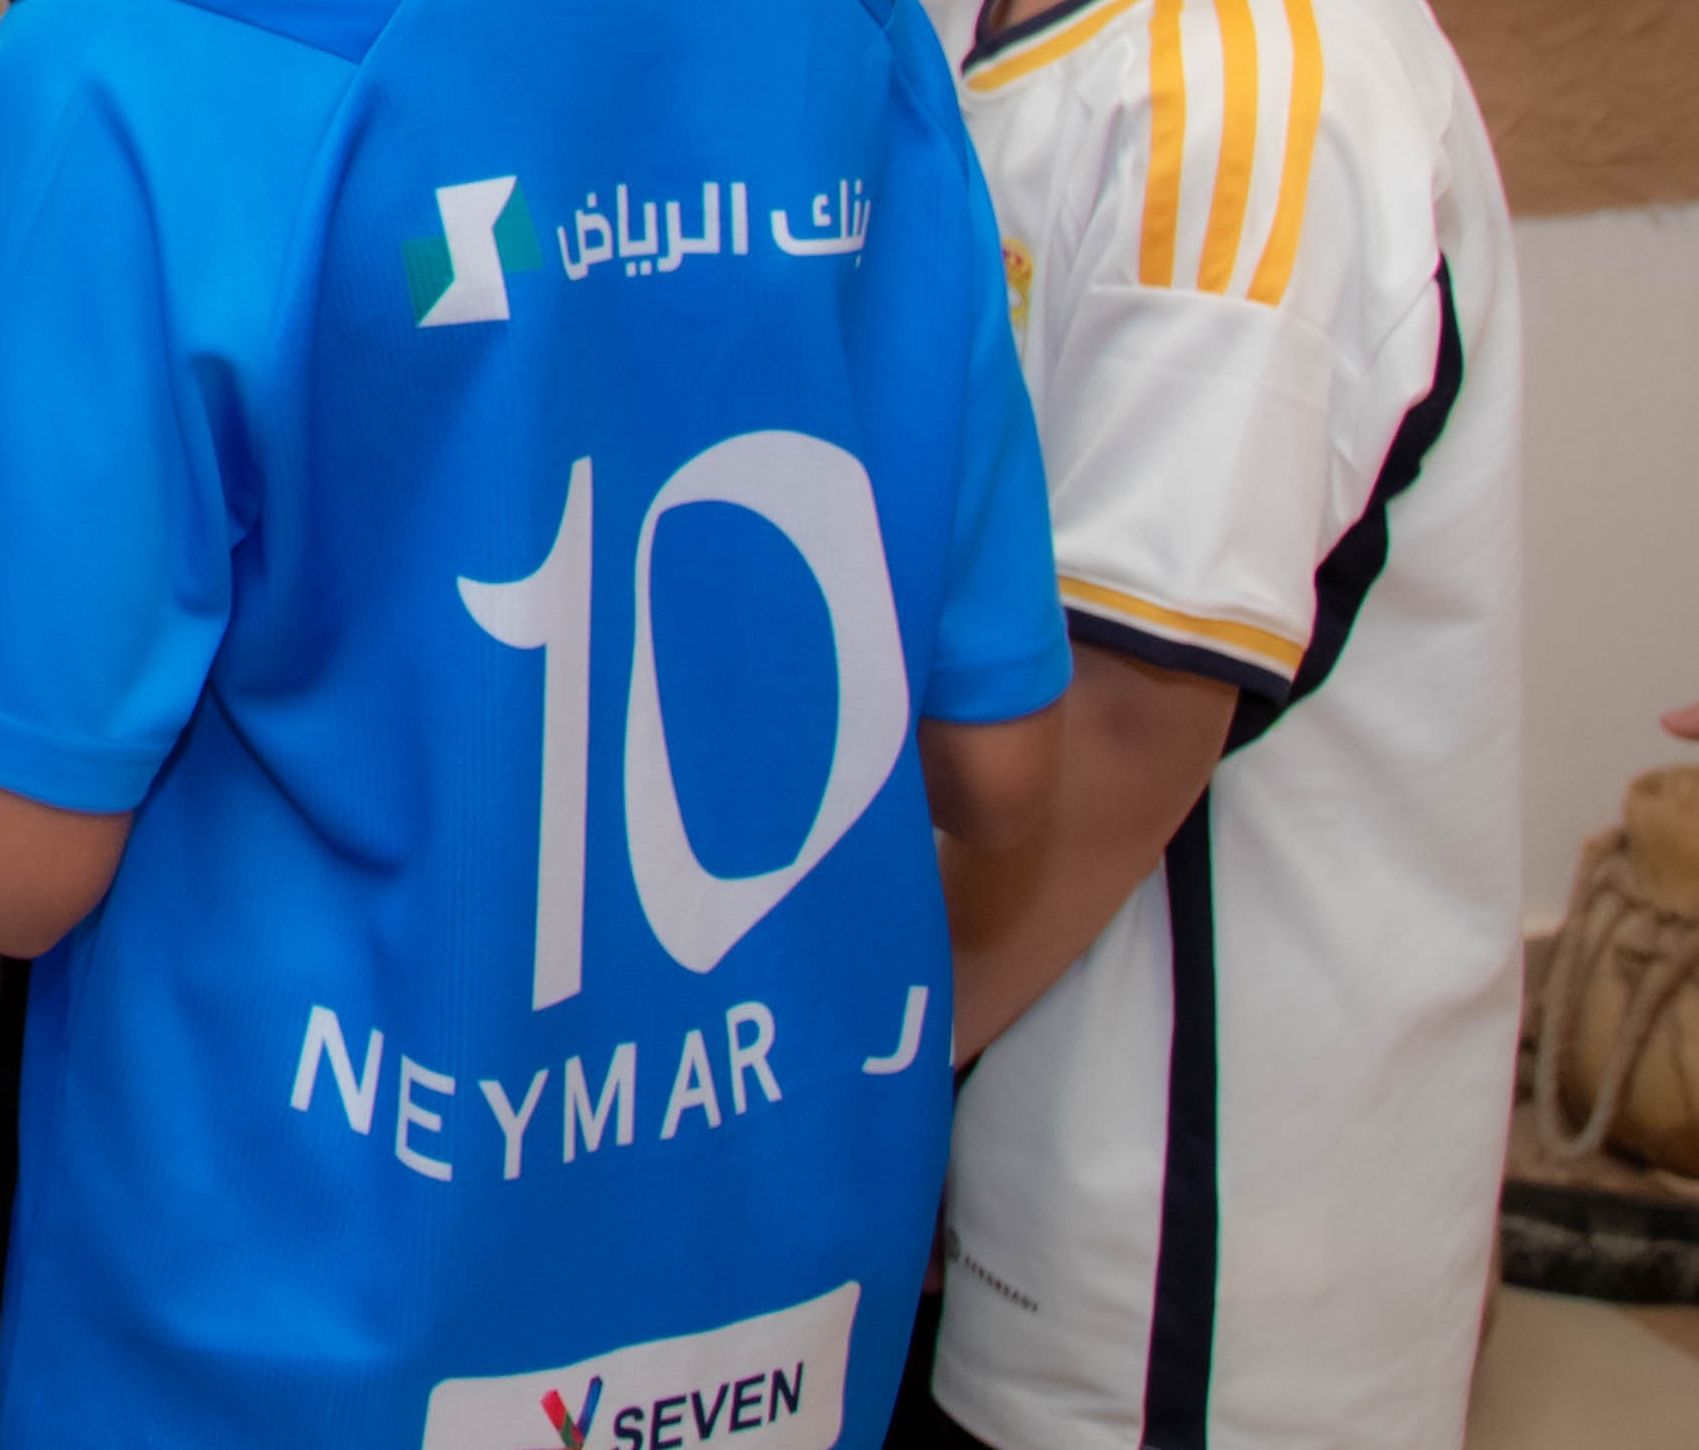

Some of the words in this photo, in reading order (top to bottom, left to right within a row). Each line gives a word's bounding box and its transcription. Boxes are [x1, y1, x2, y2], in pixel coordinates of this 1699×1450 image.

[556, 180, 749, 282] الرياض
[770, 177, 871, 269] بنك
[456, 429, 911, 1012] 10
[288, 998, 783, 1181] NEYMAR
[861, 984, 955, 1076] J
[612, 1360, 805, 1450] SEVEN
